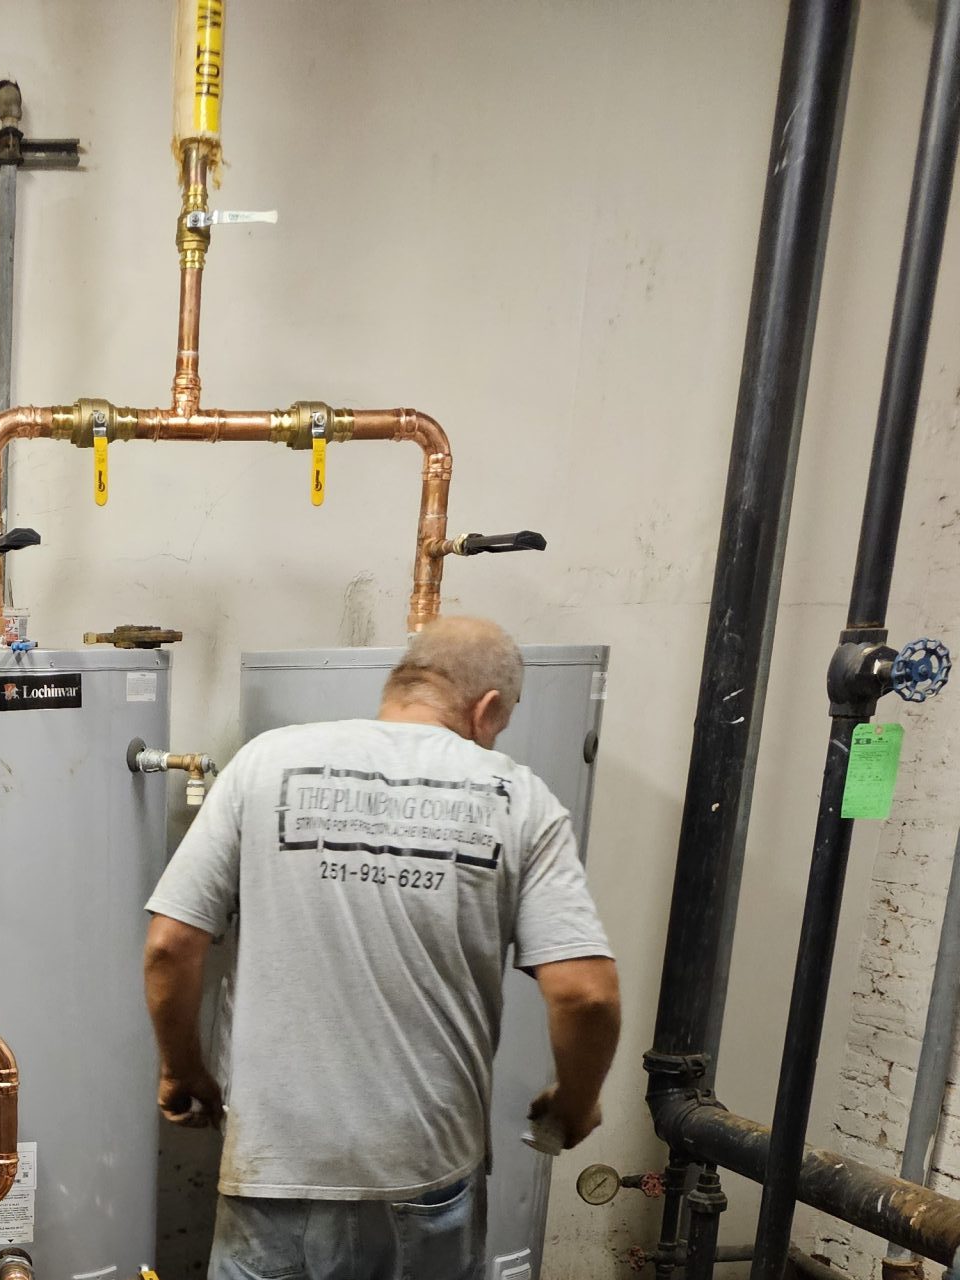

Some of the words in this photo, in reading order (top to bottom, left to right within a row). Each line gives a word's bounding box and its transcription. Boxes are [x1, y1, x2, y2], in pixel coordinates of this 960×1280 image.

[195, 44, 221, 99] HOT
[22, 683, 79, 700] Lochinvar
[298, 786, 330, 811] THE
[320, 860, 445, 891] 251-923-6237
